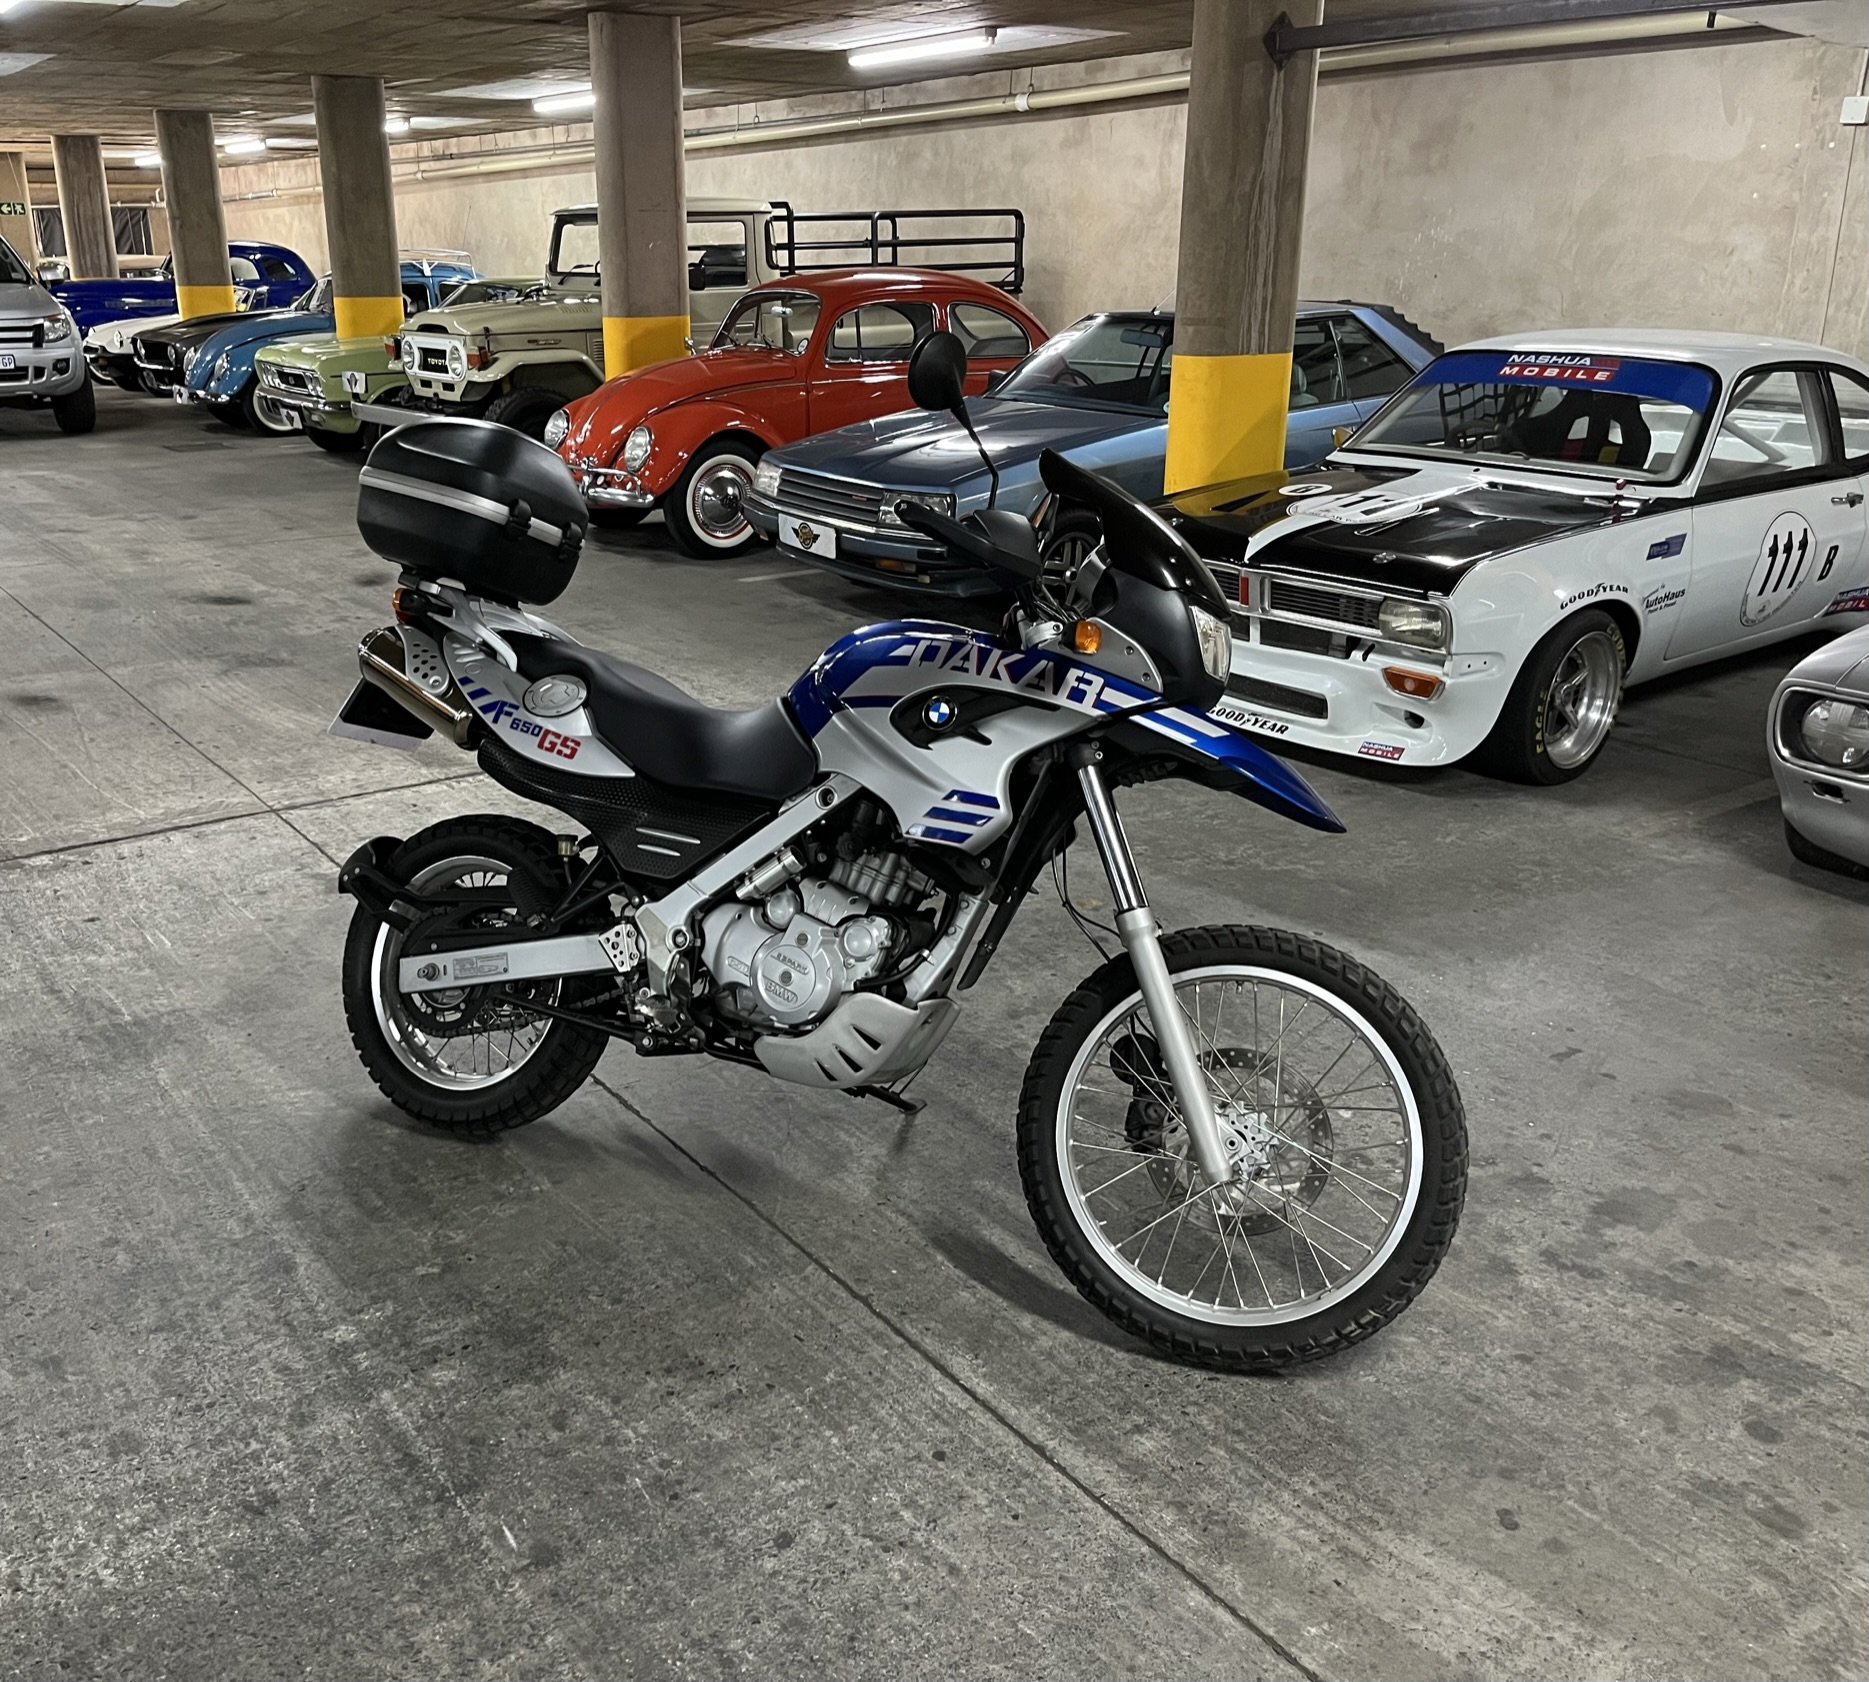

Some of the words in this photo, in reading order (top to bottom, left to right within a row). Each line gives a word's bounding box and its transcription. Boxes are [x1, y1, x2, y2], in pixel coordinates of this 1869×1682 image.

[2, 357, 12, 367] GP
[1508, 354, 1591, 366] NASHUA
[1500, 366, 1611, 381] MOBILE
[1757, 527, 1808, 597] 111
[1817, 545, 1839, 582] B
[1560, 582, 1628, 610] GOODYEAR
[1645, 588, 1686, 610] AutoHaus
[1829, 599, 1867, 611] MOBIL
[908, 639, 1105, 711] DAKAR
[1360, 747, 1400, 759] MOBILE
[766, 981, 795, 1003] BMW
